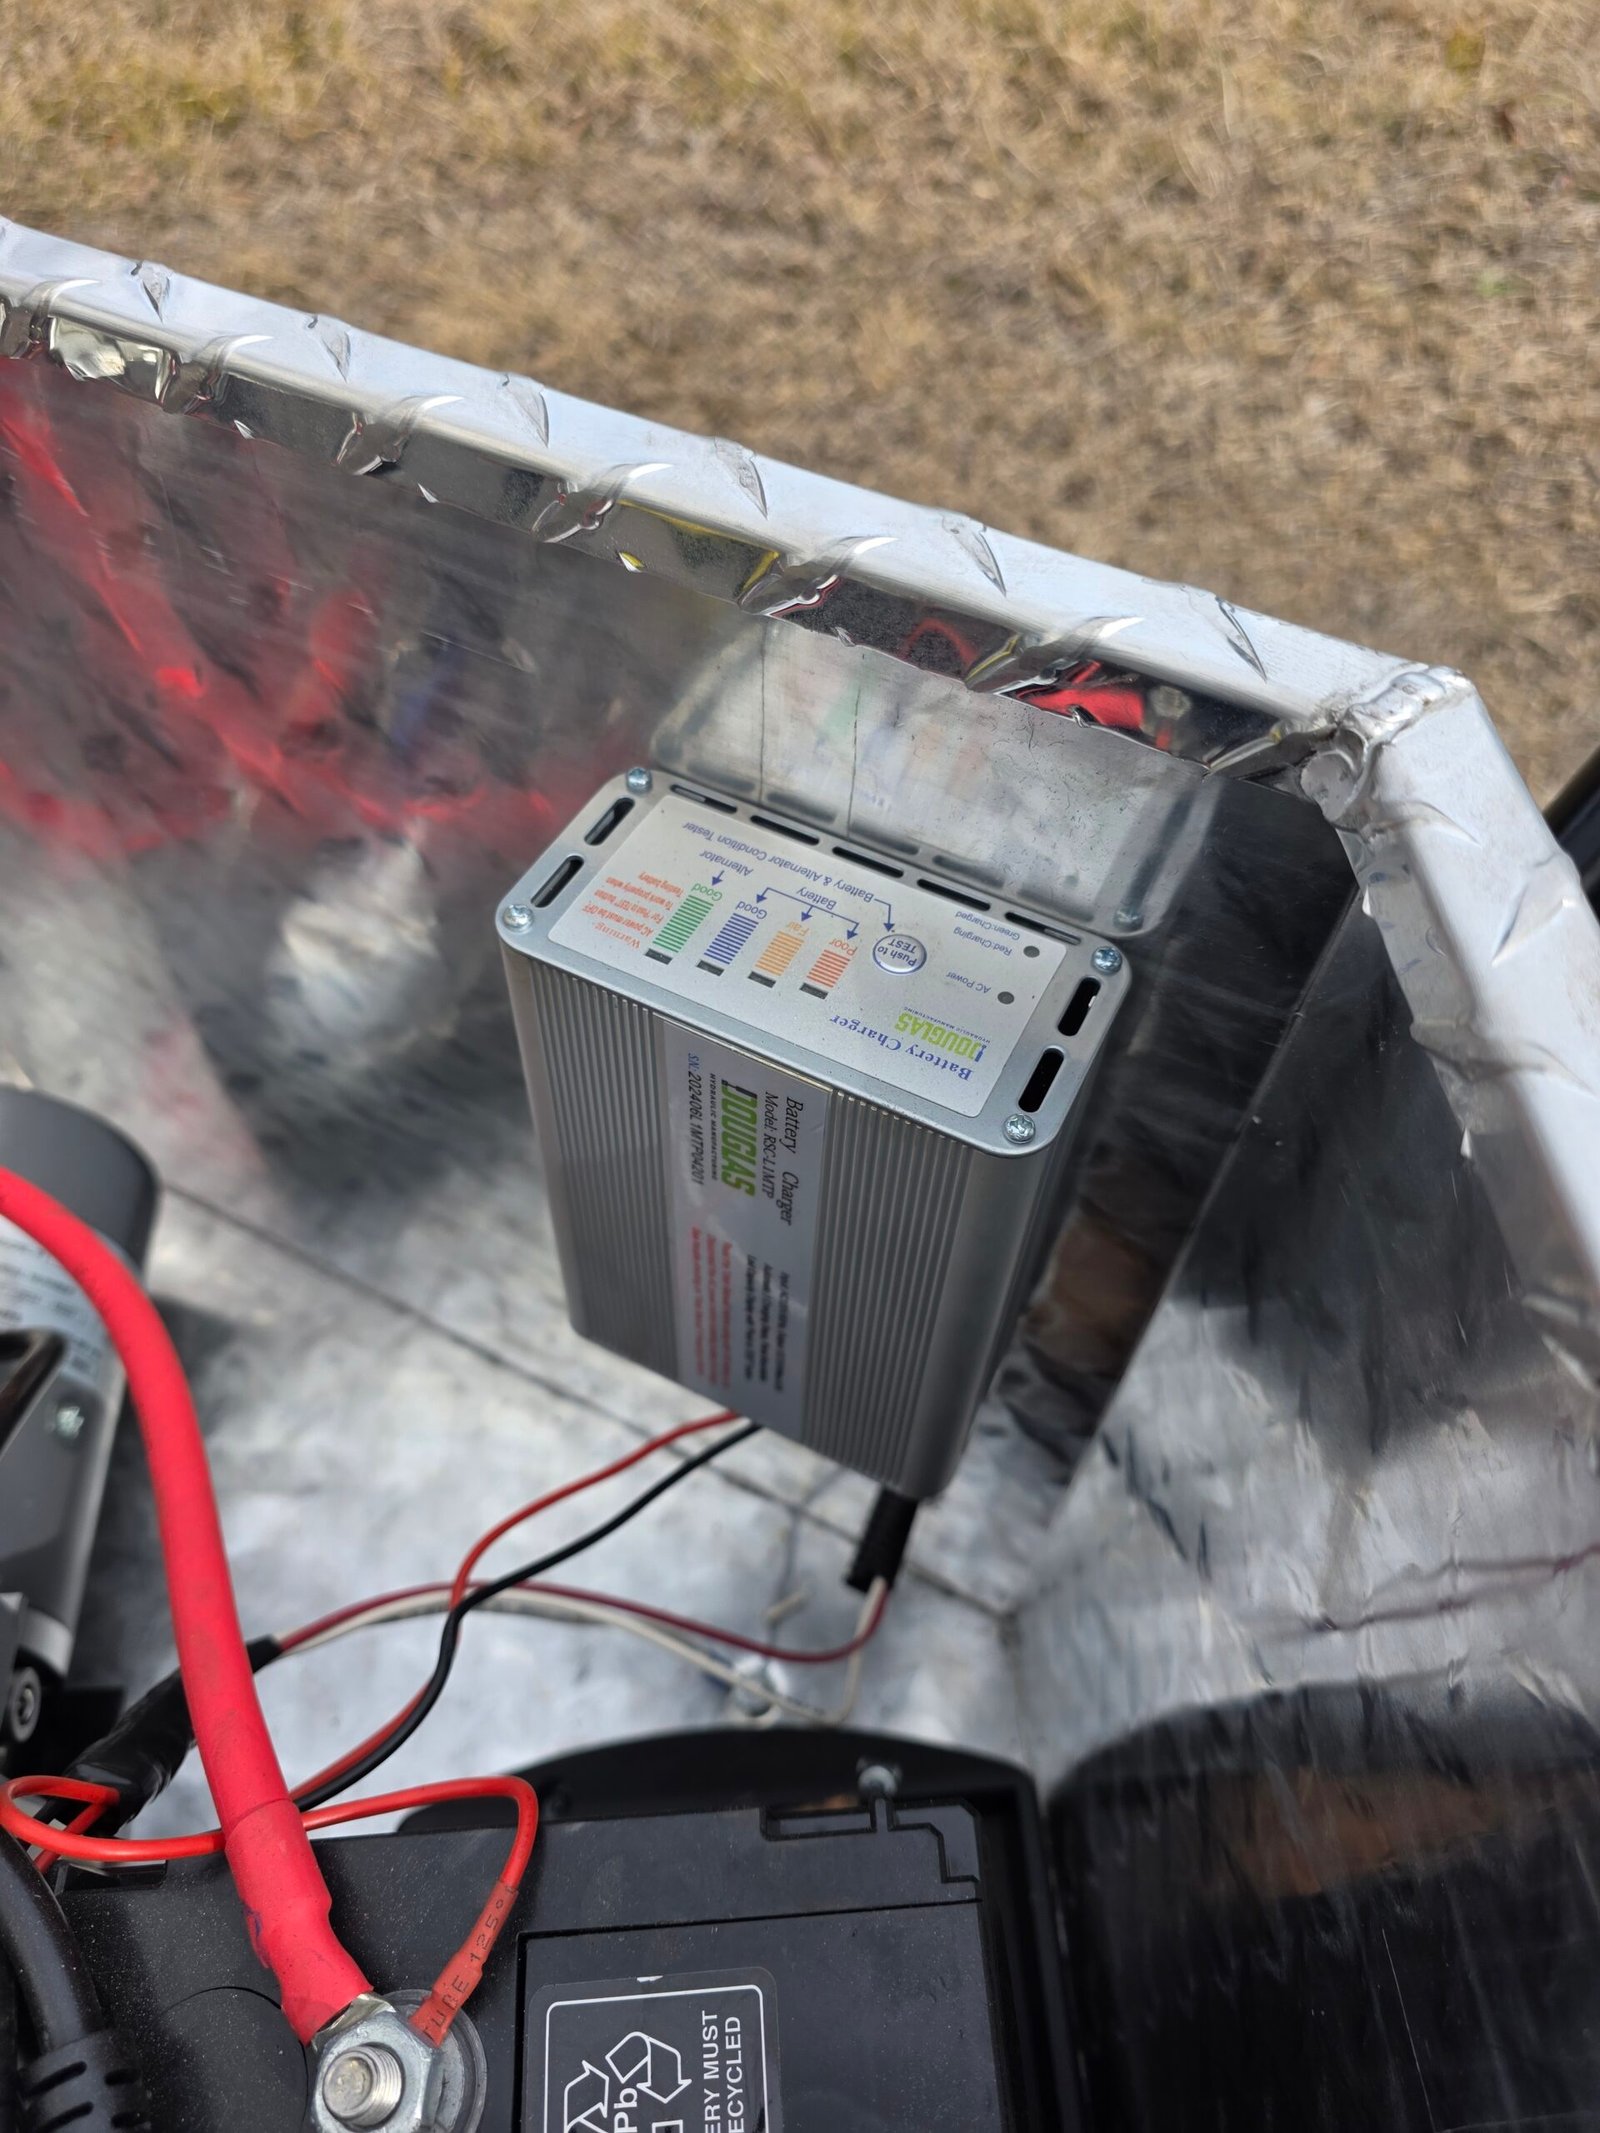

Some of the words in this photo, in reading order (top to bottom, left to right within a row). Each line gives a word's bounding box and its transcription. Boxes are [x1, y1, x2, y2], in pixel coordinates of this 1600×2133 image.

[682, 821, 713, 841] Tester
[717, 834, 768, 861] Condition
[699, 851, 754, 877] Alternator
[768, 855, 823, 882] Alternator
[691, 883, 723, 902] Good
[823, 876, 832, 887] &
[833, 879, 874, 903] Battery
[735, 901, 768, 920] Good
[797, 886, 837, 911] Battery
[786, 921, 809, 936] Fair
[829, 938, 858, 957] Poor
[877, 946, 888, 955] to
[888, 938, 917, 954] TEST
[889, 948, 918, 967] Push
[946, 971, 975, 988] Power
[975, 983, 992, 994] AC
[829, 1014, 902, 1051] Charger
[894, 1012, 987, 1062] DOUGLAS
[905, 1043, 975, 1081] Battery
[764, 1091, 779, 1131] Model:
[779, 1096, 804, 1154] Battery
[710, 1119, 718, 1181] MANUFACTURING
[721, 1079, 758, 1197] DOUGLAS
[776, 1170, 799, 1226] Charger
[701, 2010, 720, 2081] MUST
[613, 2087, 638, 2133] Pb
